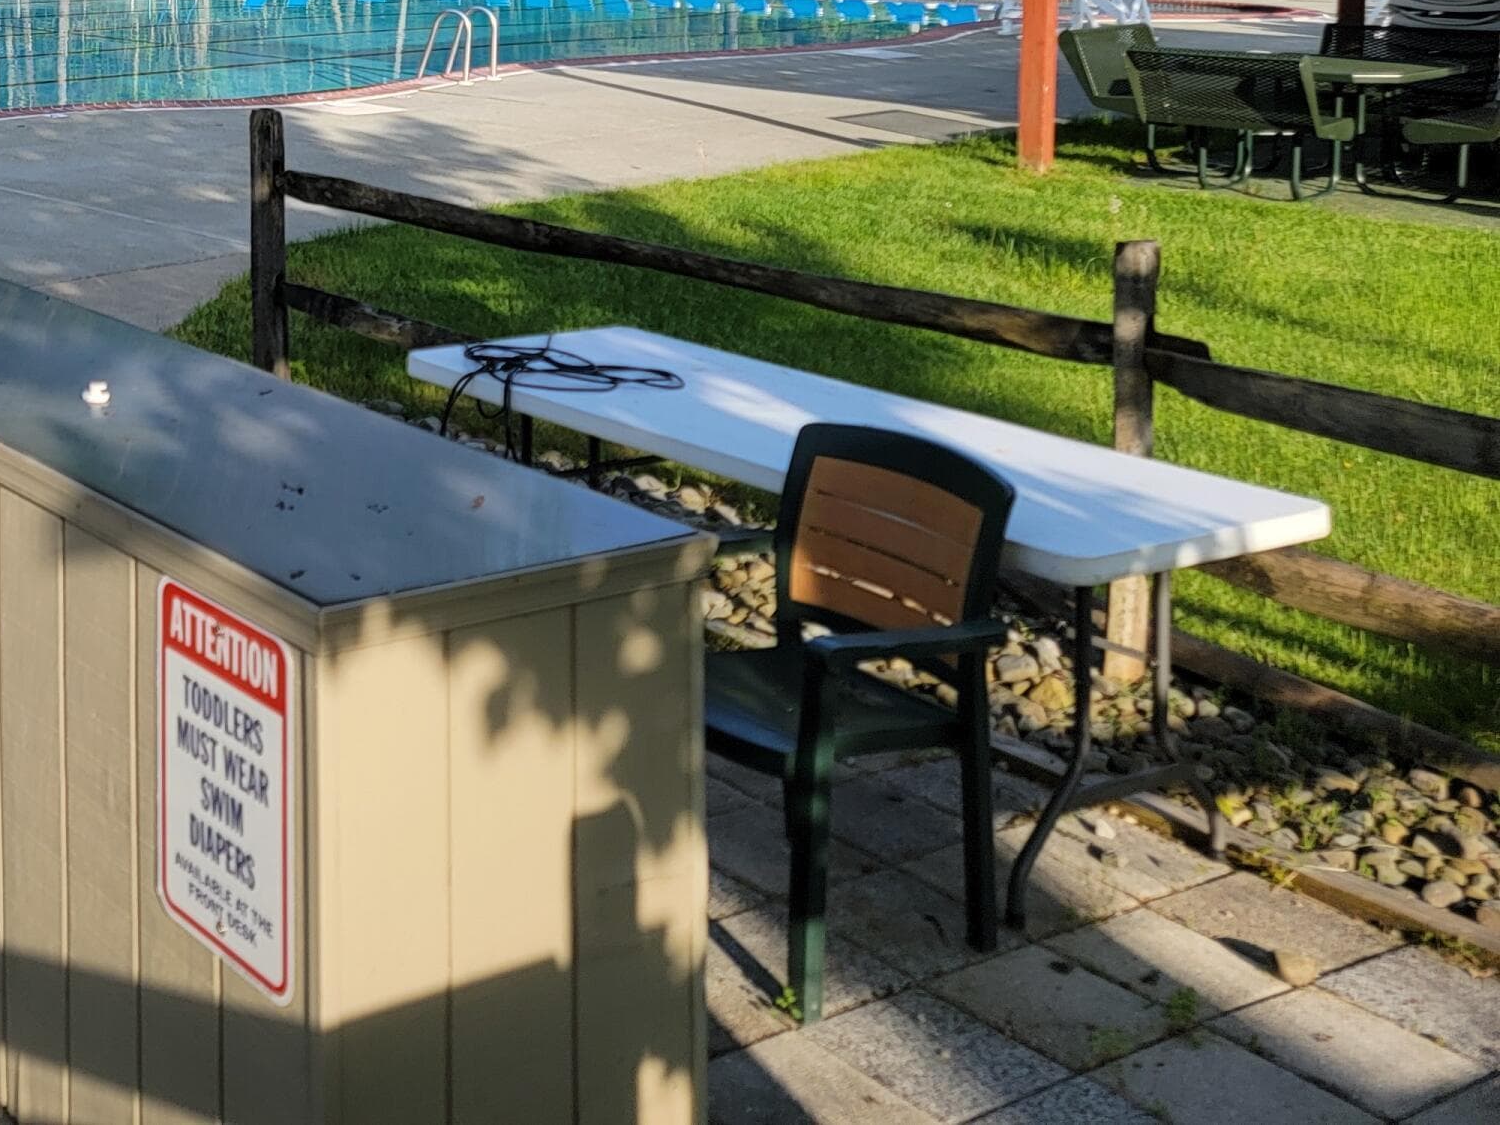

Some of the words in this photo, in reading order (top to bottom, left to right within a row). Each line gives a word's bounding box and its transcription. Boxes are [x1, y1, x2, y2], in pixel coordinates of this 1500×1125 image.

[170, 597, 278, 700] ATTENTION
[183, 675, 263, 756] TODDLERS
[177, 716, 217, 773] MUST
[223, 746, 268, 808] WEAR
[201, 776, 243, 836] SWIM
[190, 814, 256, 891] DIAPERS
[175, 851, 232, 906] AVAILABLE
[236, 898, 249, 918] AT
[252, 909, 274, 939] THE
[189, 882, 223, 919] FRONT
[227, 912, 257, 947] DESK
